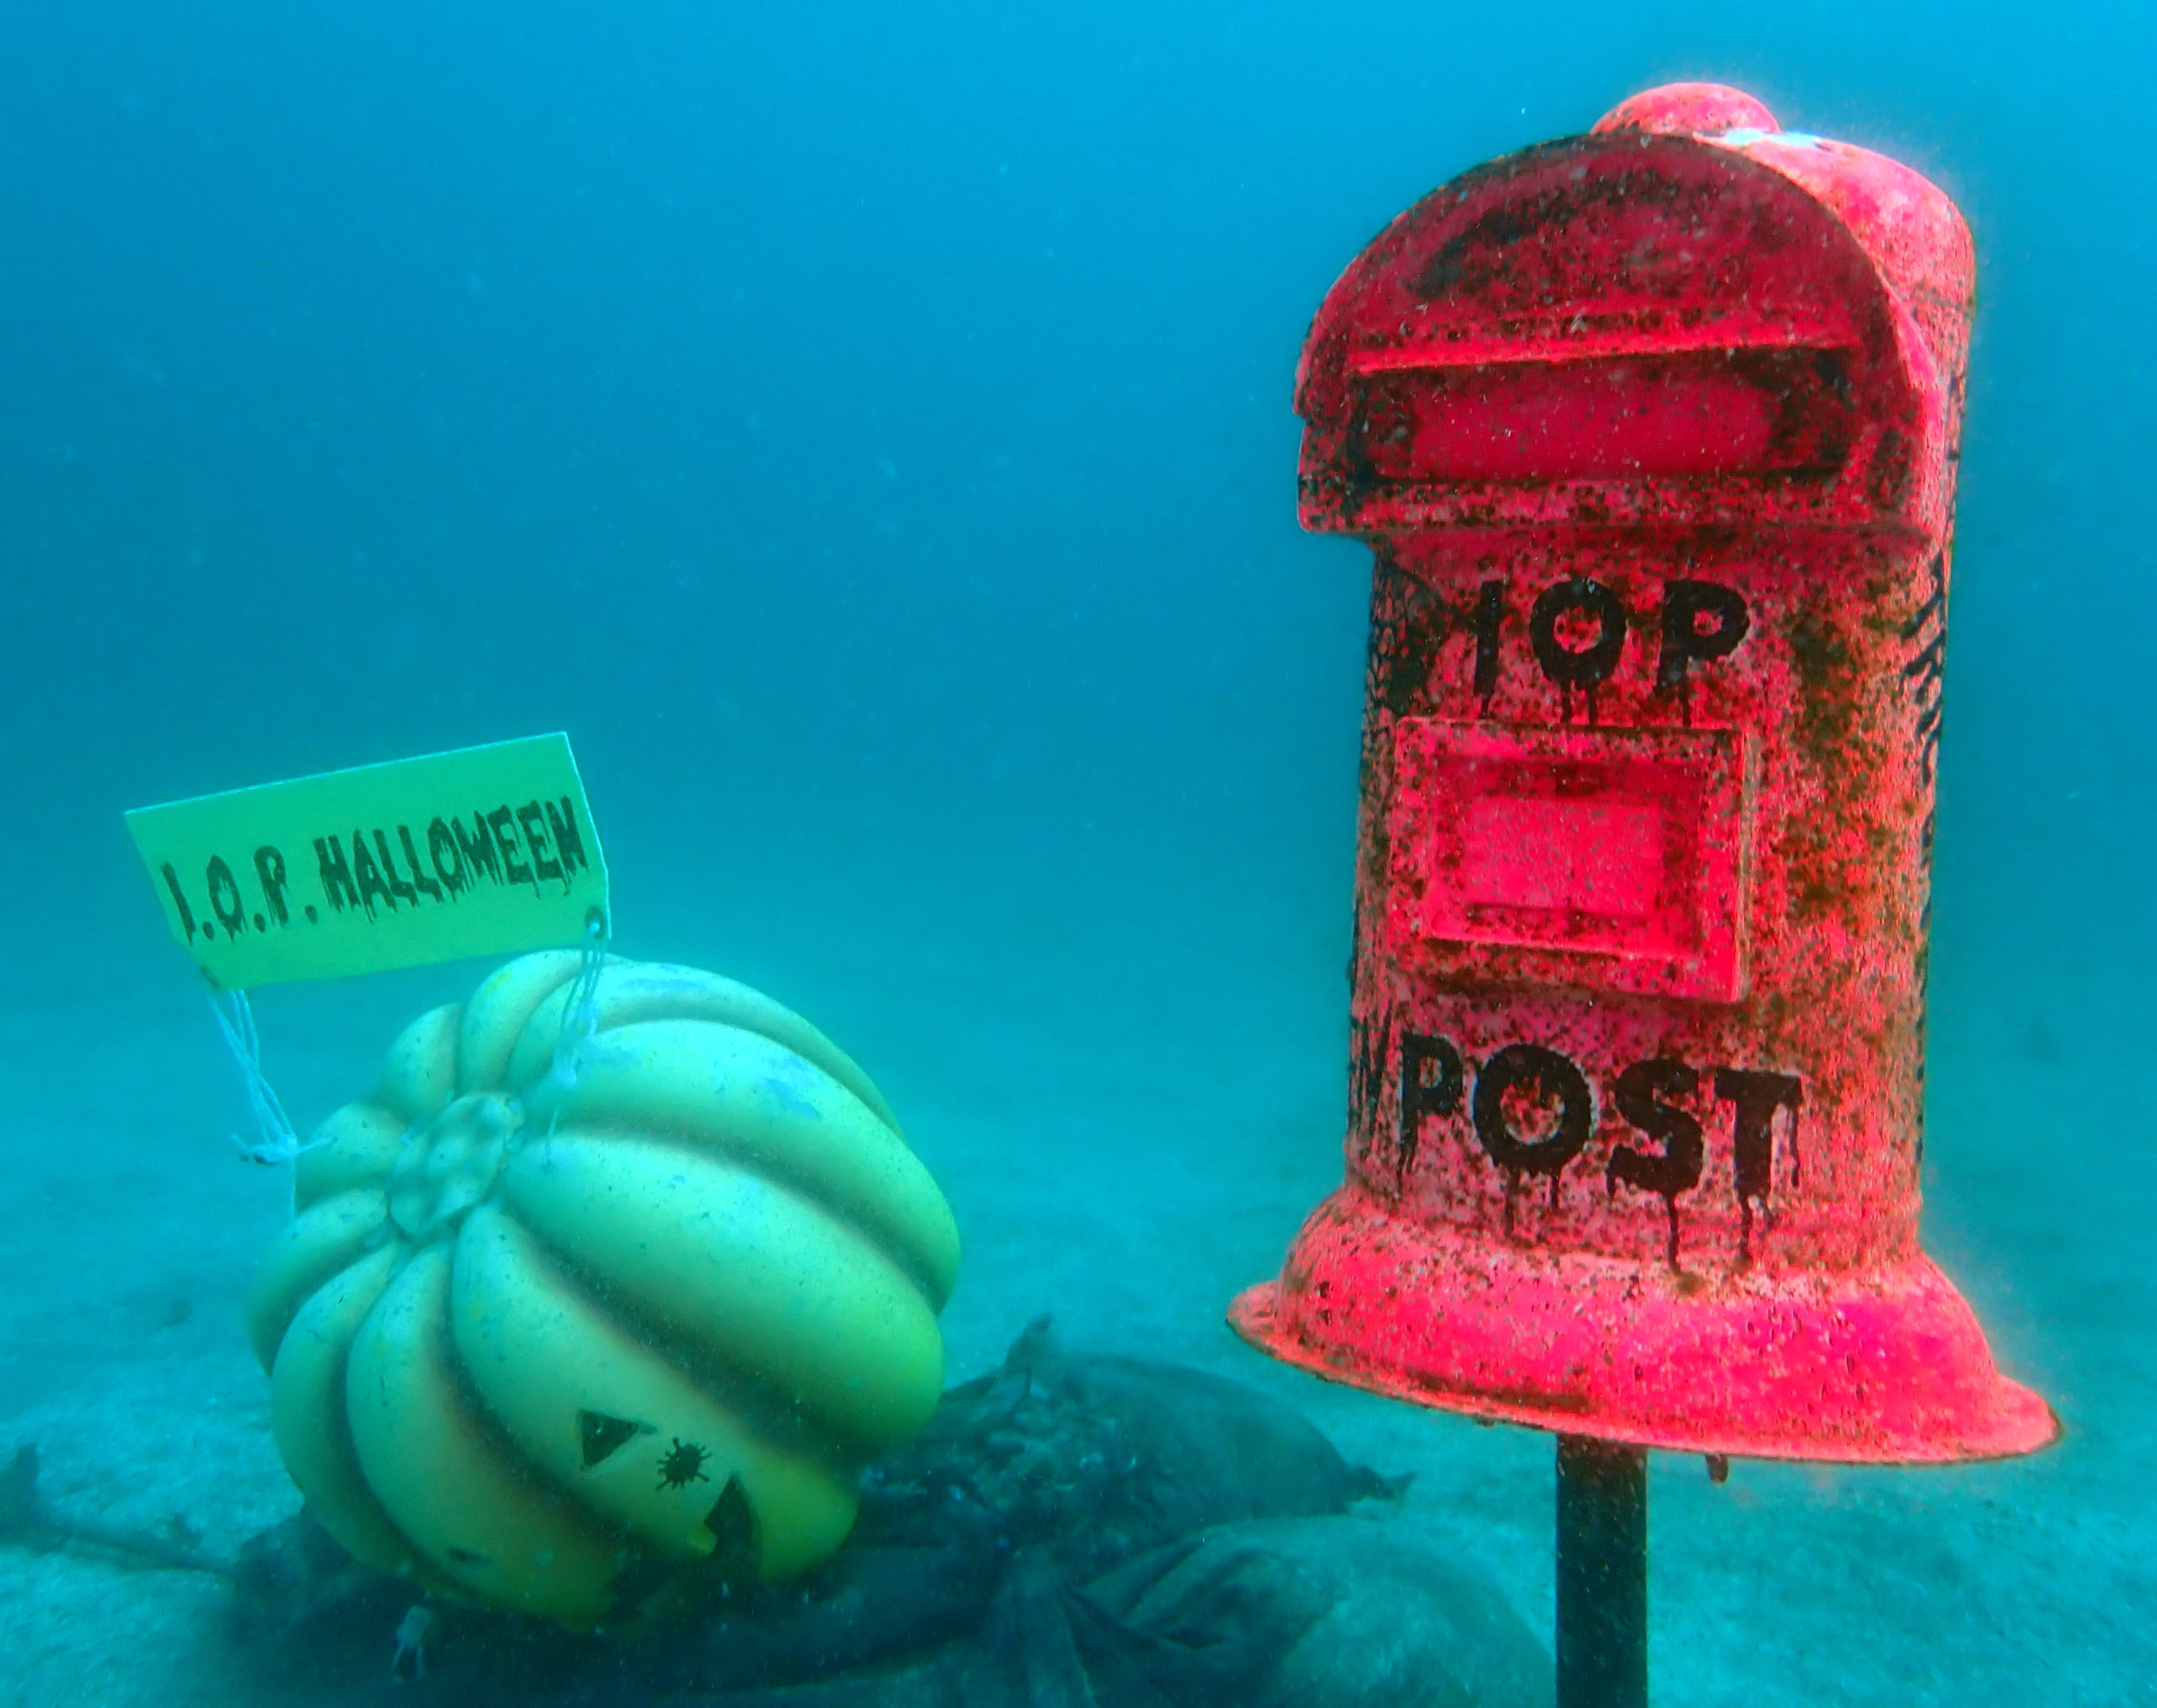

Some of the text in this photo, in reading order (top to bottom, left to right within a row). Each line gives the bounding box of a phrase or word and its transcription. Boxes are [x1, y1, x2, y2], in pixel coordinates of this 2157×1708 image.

[1475, 577, 1751, 715] IOP
[159, 795, 589, 945] I.O.P. HALLOWEEN
[1397, 1031, 1803, 1234] POST
